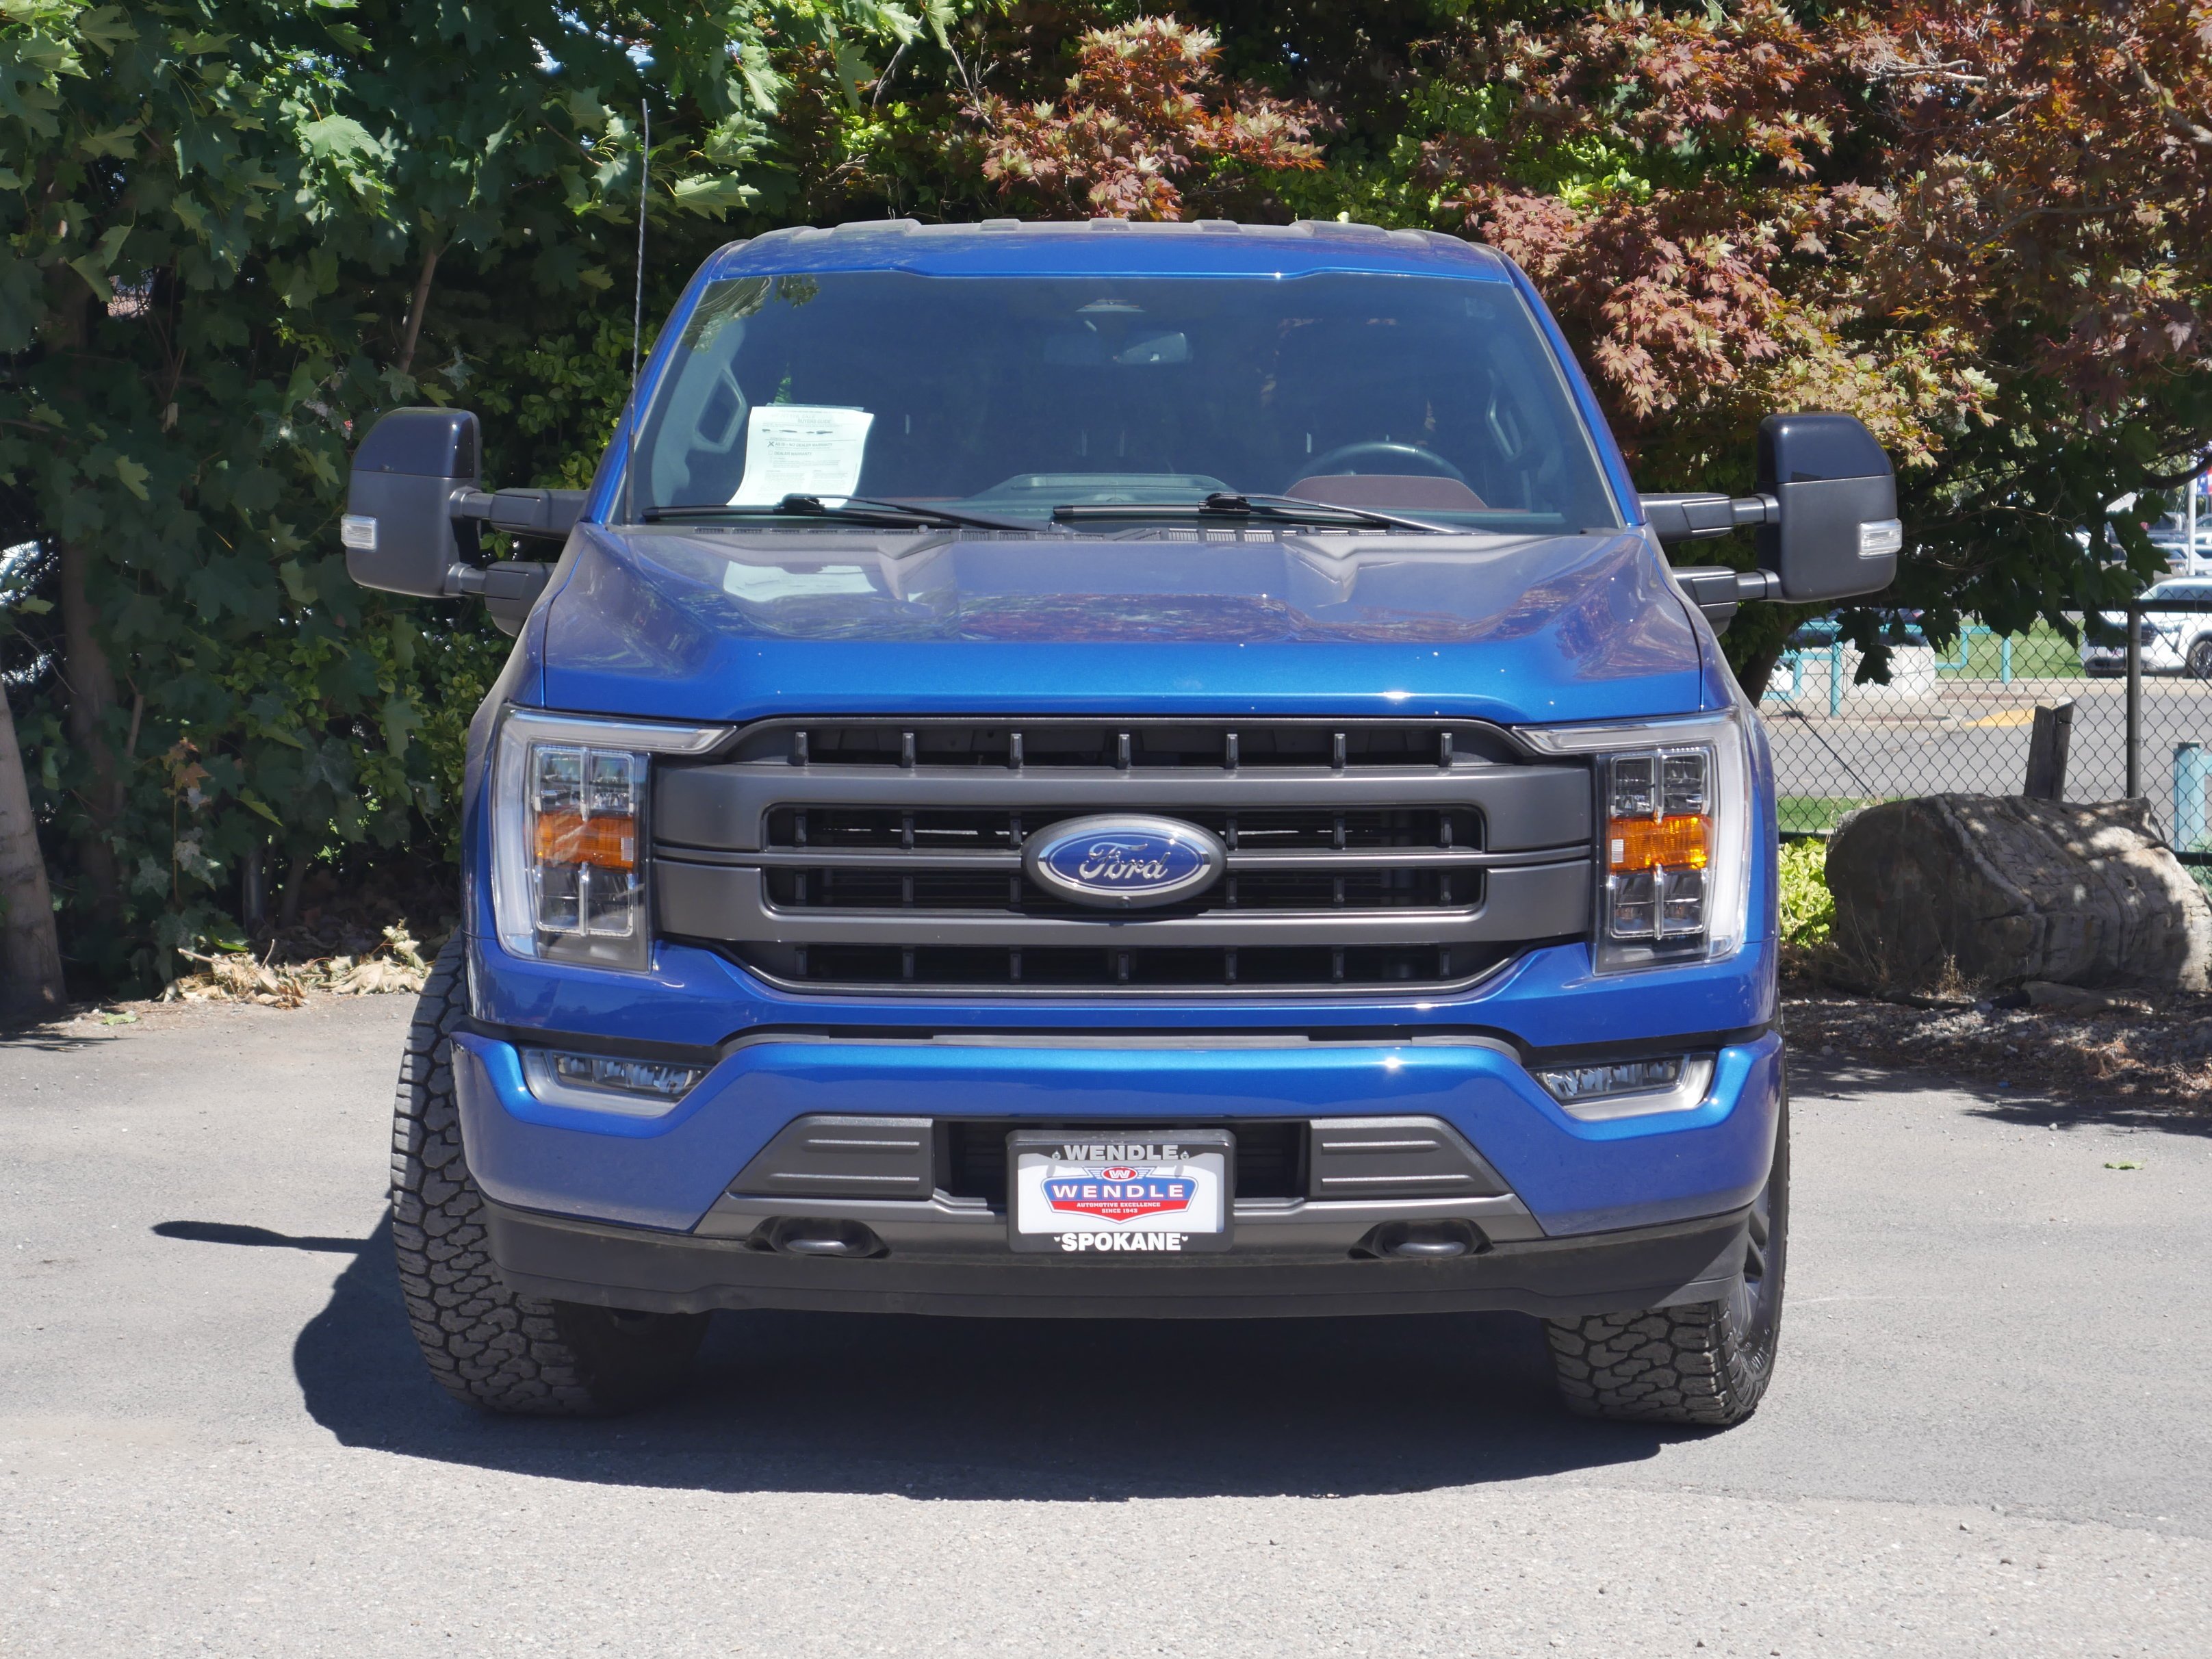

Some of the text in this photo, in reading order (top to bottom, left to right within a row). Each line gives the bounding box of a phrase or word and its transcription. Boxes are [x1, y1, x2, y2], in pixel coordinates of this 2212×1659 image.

[1079, 842, 1171, 879] Ford
[1064, 1144, 1179, 1160] WENDLE
[1108, 1170, 1131, 1179] W
[1053, 1185, 1183, 1198] WENDLE
[1061, 1232, 1181, 1251] SPOKANE
